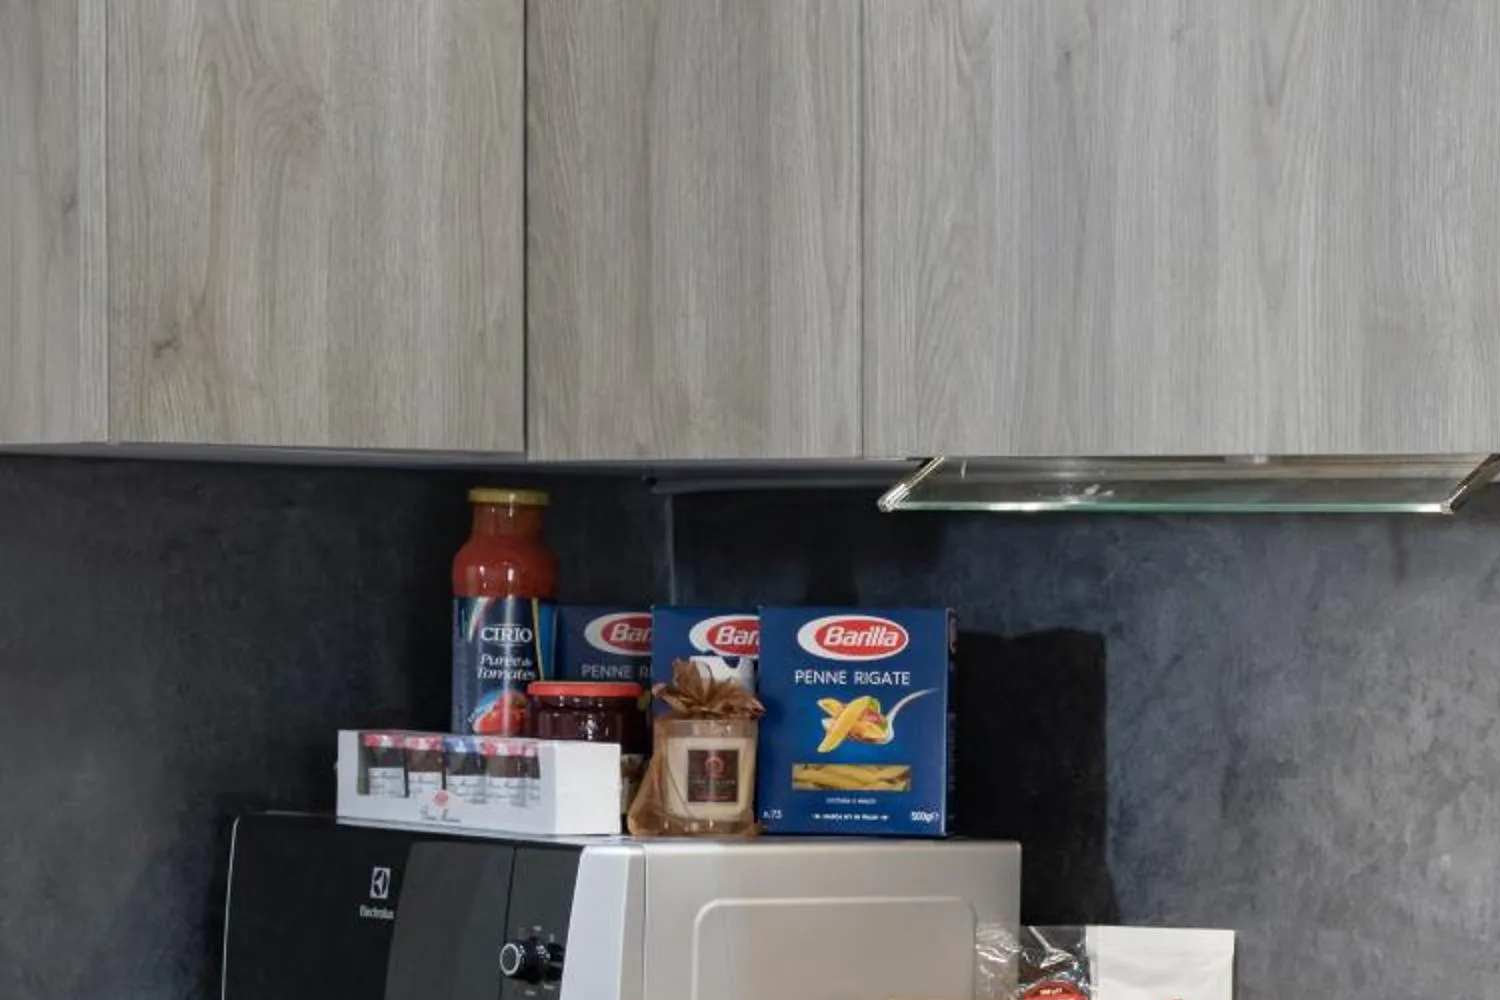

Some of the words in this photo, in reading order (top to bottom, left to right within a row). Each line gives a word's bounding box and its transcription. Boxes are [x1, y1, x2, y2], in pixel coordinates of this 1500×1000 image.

[481, 627, 533, 643] CIRIO
[823, 625, 899, 648] Barilla
[580, 664, 632, 679] PENNE
[794, 669, 847, 685] PENNE
[854, 670, 911, 686] RIGATE
